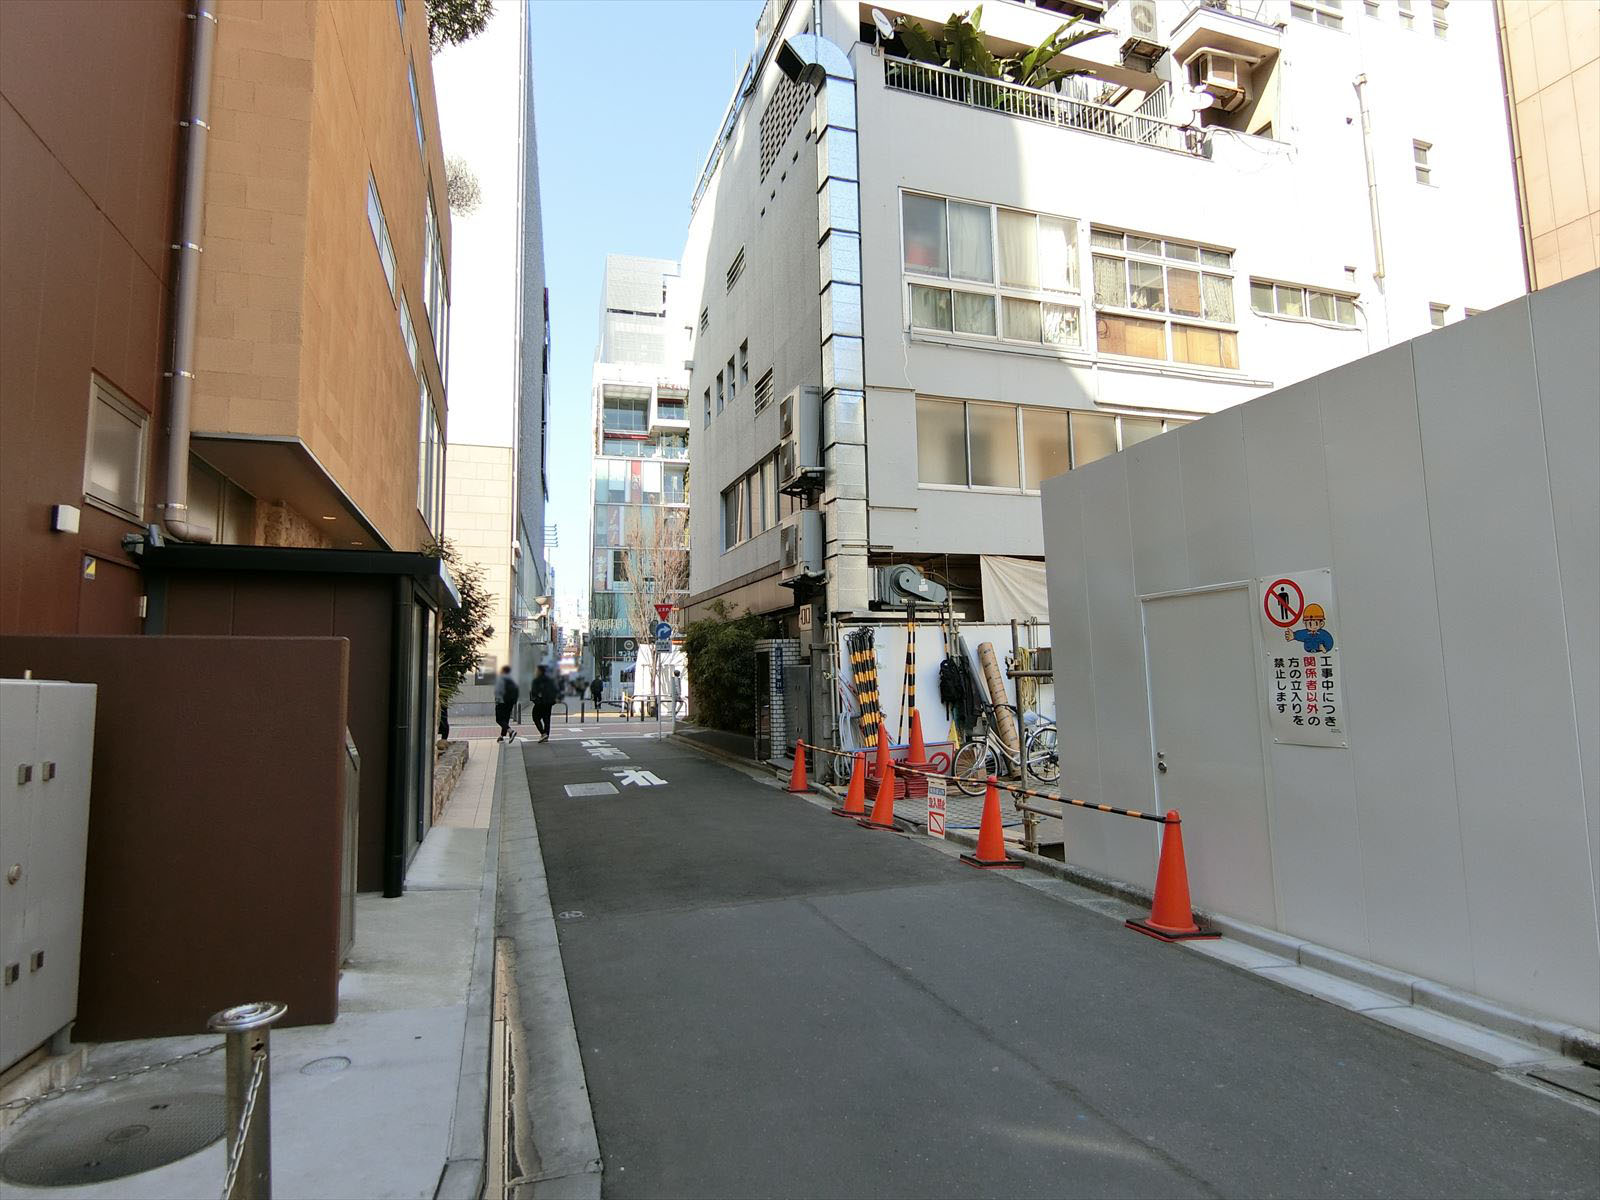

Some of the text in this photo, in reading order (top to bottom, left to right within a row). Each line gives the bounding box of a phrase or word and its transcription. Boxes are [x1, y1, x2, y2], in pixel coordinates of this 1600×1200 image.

[1274, 657, 1288, 714] 禁止します
[1288, 657, 1304, 726] 方の立入りを
[1303, 656, 1321, 727] 関係者以外の
[1320, 656, 1337, 727] 工事中につき
